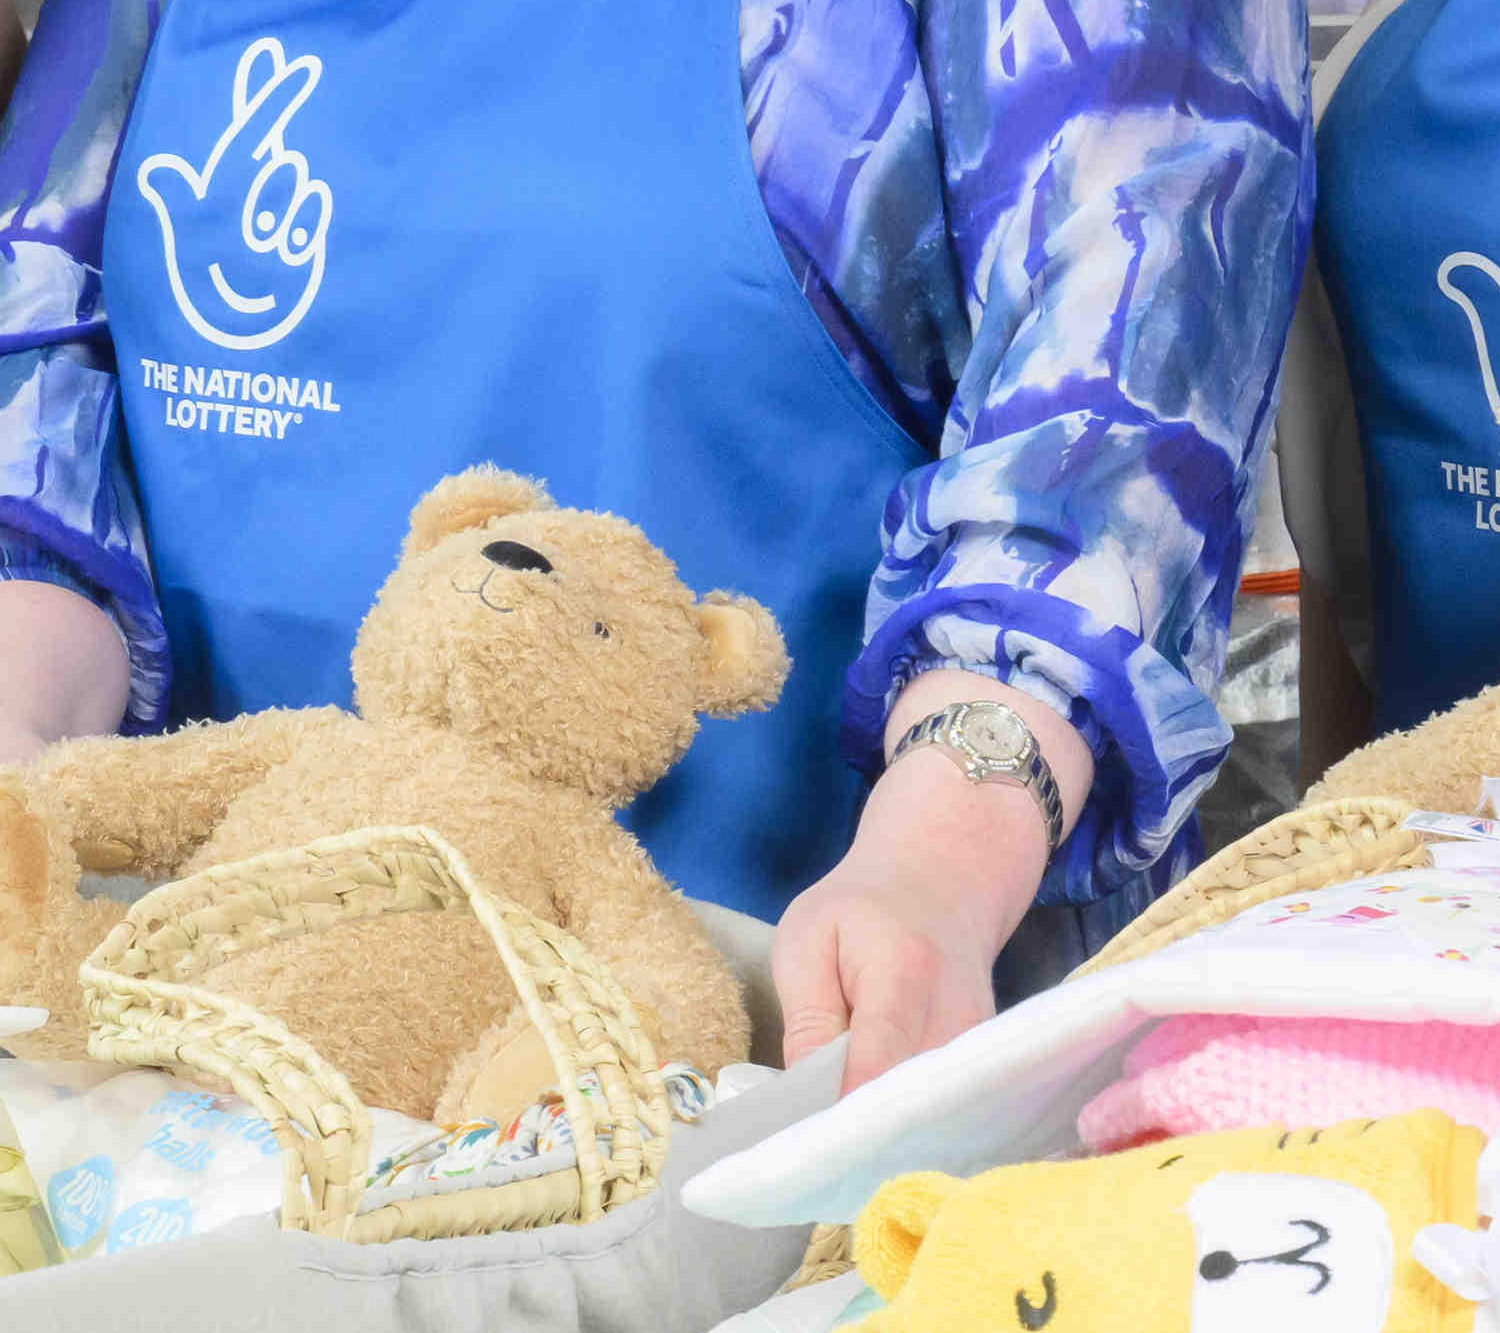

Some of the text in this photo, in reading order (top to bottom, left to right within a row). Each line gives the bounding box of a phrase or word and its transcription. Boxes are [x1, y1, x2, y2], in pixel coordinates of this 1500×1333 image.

[140, 358, 341, 412] THE NATIONAL
[1440, 461, 1491, 497] THE
